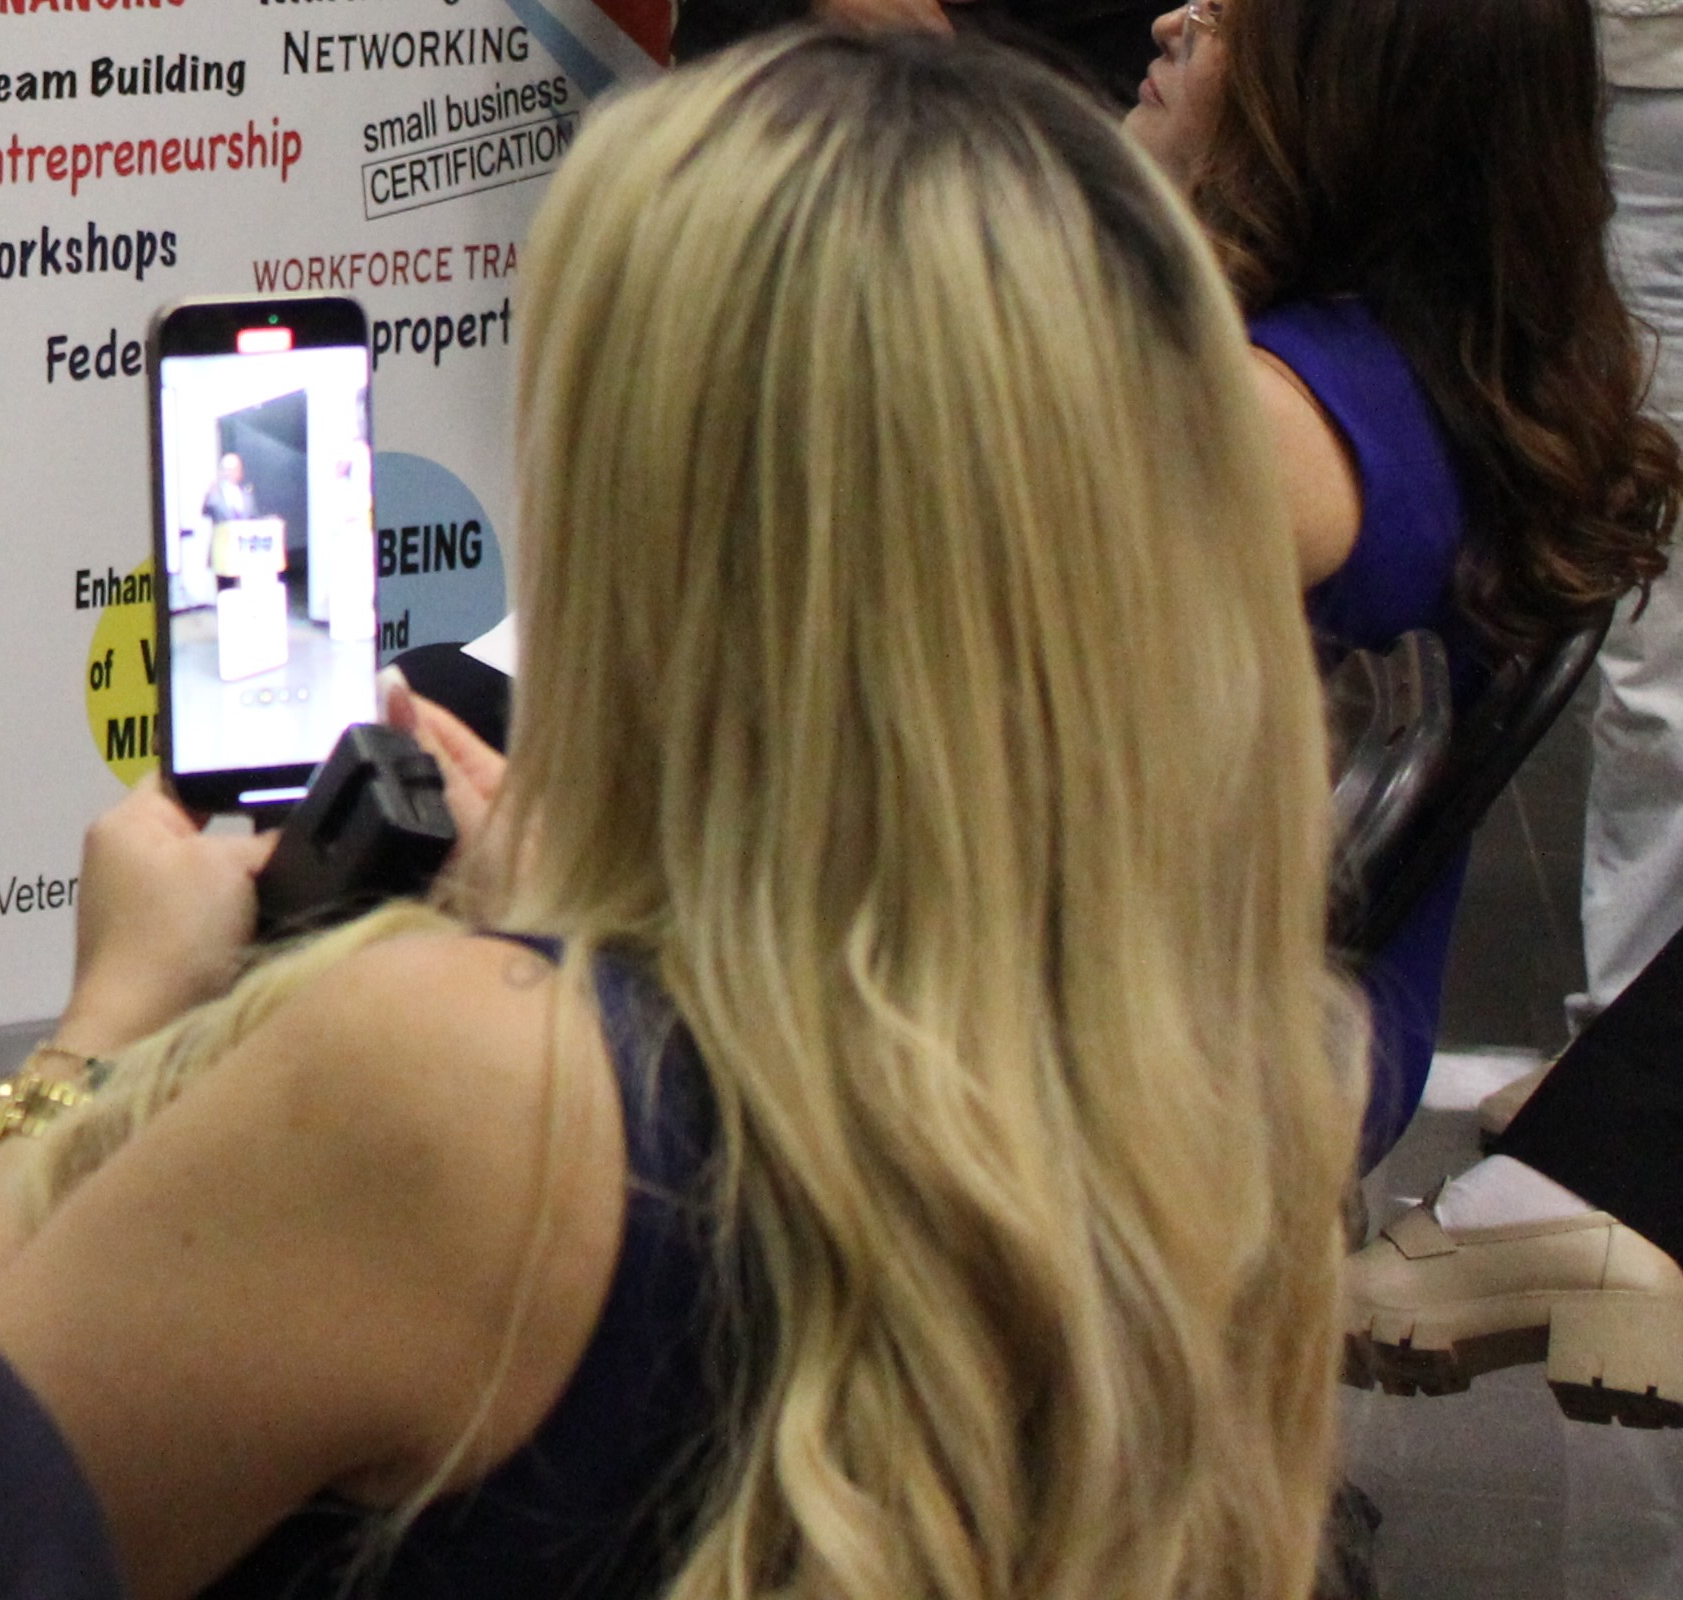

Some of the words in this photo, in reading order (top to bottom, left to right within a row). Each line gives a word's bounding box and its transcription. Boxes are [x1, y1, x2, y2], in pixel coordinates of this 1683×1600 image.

[283, 25, 530, 75] NETWORKING
[91, 54, 247, 97] Building
[364, 99, 437, 152] small
[446, 76, 568, 132] business
[253, 247, 453, 293] WORKFORCE
[90, 648, 114, 691] of
